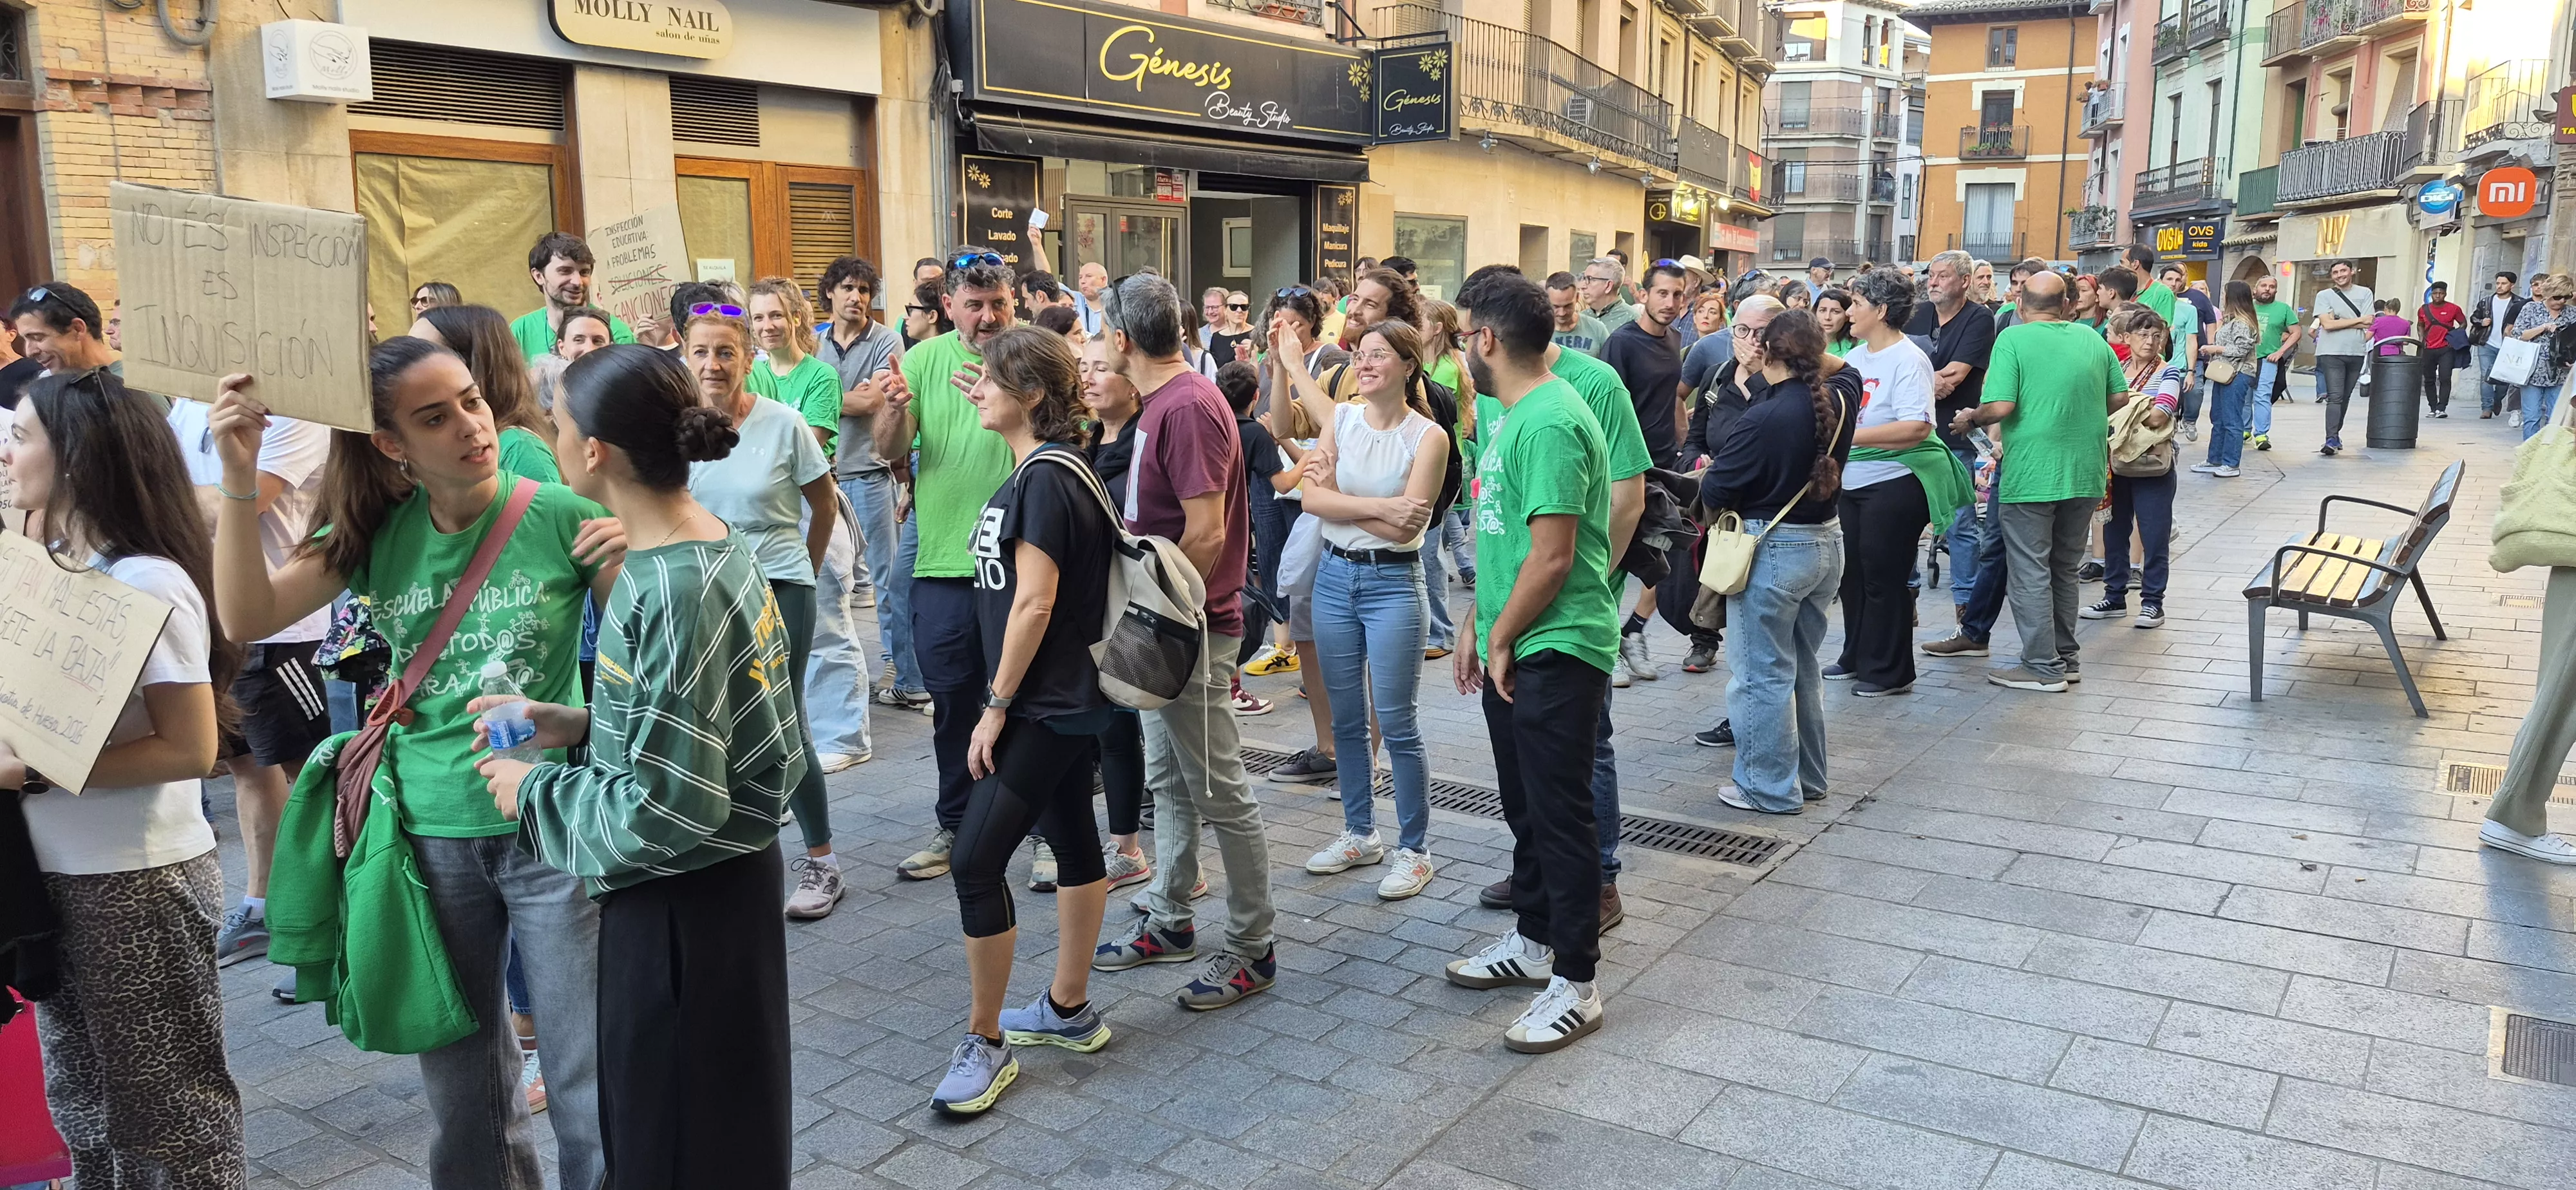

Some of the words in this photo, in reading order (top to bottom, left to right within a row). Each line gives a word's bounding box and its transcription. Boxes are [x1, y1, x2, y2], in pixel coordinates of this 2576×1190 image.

[574, 0, 652, 23] MOLLY
[667, 6, 719, 32] NAIL
[656, 28, 681, 40] salon
[683, 32, 695, 42] de
[699, 35, 720, 44] uñas
[1099, 24, 1232, 92] Génesis
[1204, 91, 1258, 126] Beauty
[1256, 101, 1291, 129] Studio
[1383, 89, 1441, 113] Génesis
[2420, 193, 2454, 203] DIGI
[131, 202, 164, 247] NO
[605, 214, 643, 236] INSPECCIÓN
[991, 207, 1014, 220] Corte
[988, 229, 1016, 242] Lavado
[1322, 223, 1350, 234] Maquillaje
[2157, 227, 2174, 252] OVS
[2188, 225, 2214, 236] OVS
[611, 243, 656, 269] PROBLEMAS
[1324, 259, 1347, 268] Pedicura
[202, 270, 238, 299] ES
[133, 304, 334, 379] INQUISICIÓN
[370, 581, 453, 621] ESCUELA
[33, 627, 57, 661] LA
